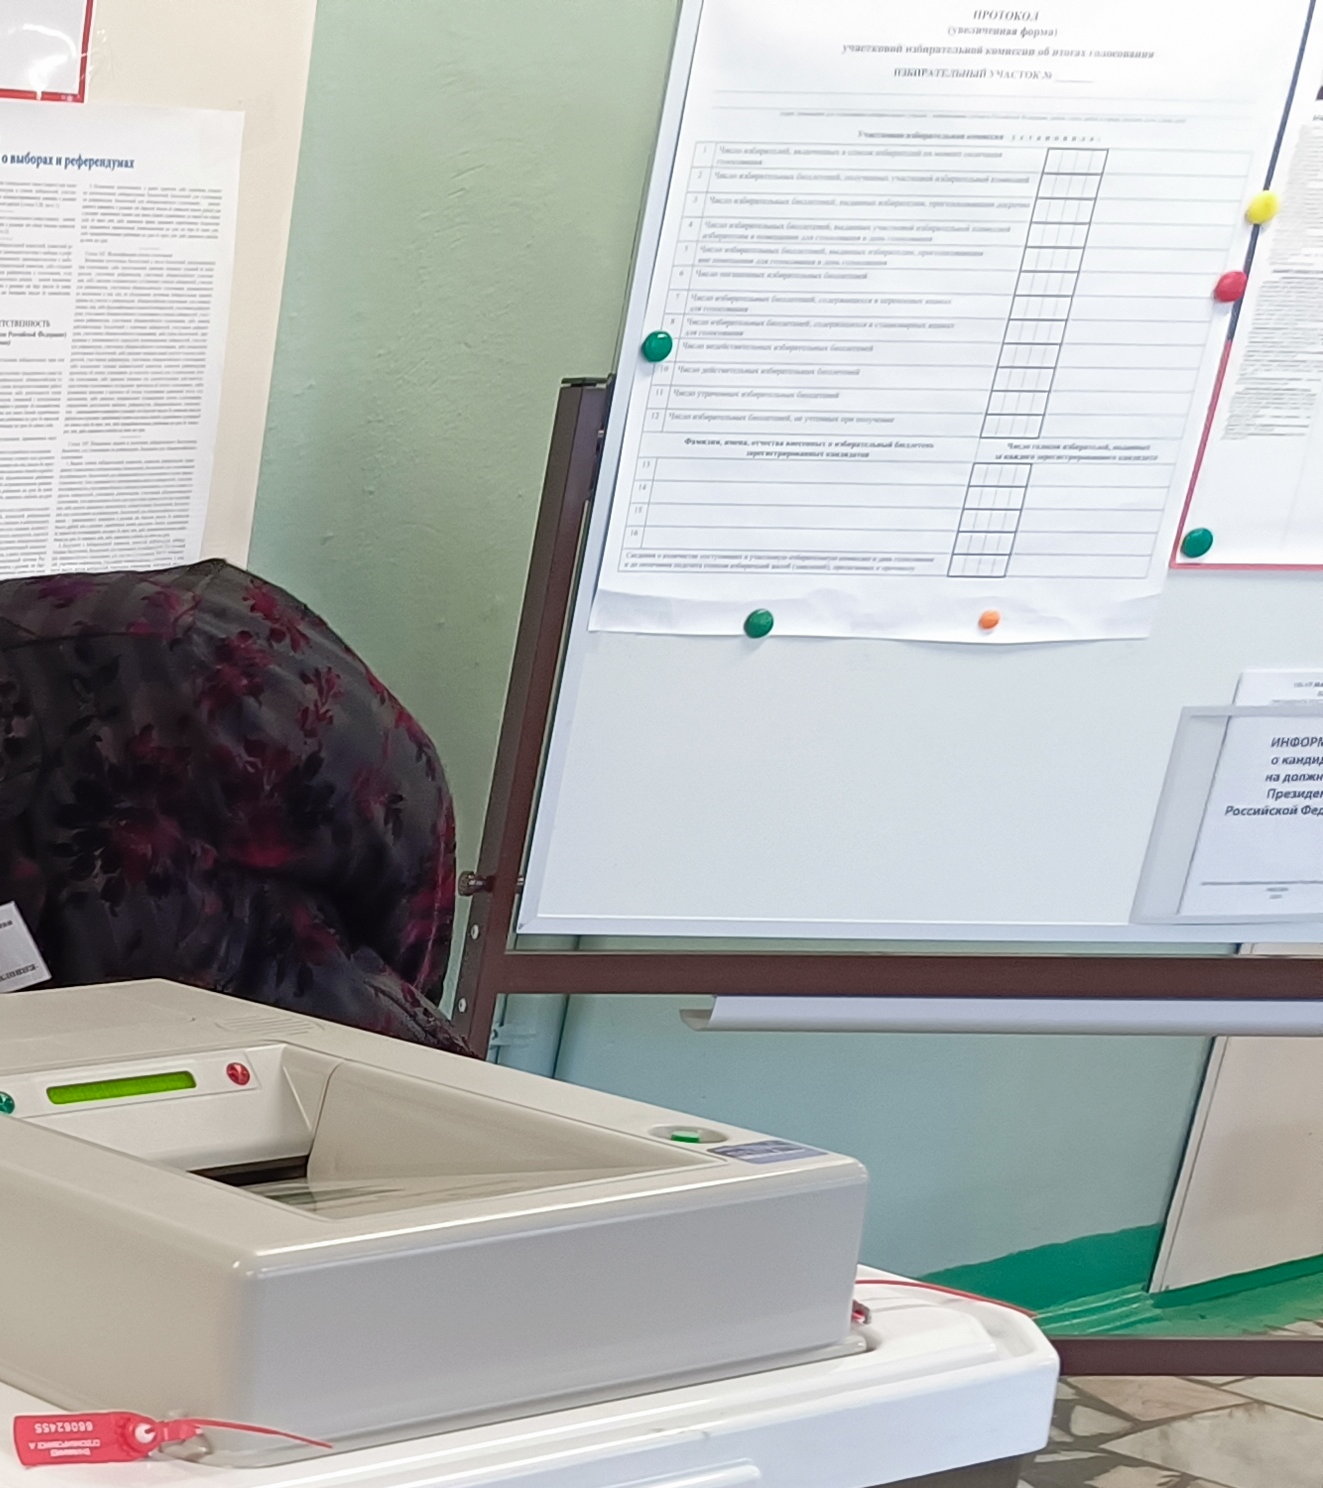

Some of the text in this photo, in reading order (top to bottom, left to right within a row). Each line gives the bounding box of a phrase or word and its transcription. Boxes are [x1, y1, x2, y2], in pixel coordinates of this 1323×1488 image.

[1, 154, 7, 163] о
[10, 150, 52, 168] выборах
[55, 156, 61, 165] и
[64, 153, 135, 172] референдумах
[1271, 756, 1279, 765] о
[1265, 774, 1281, 782] на
[1224, 804, 1298, 816] Российской
